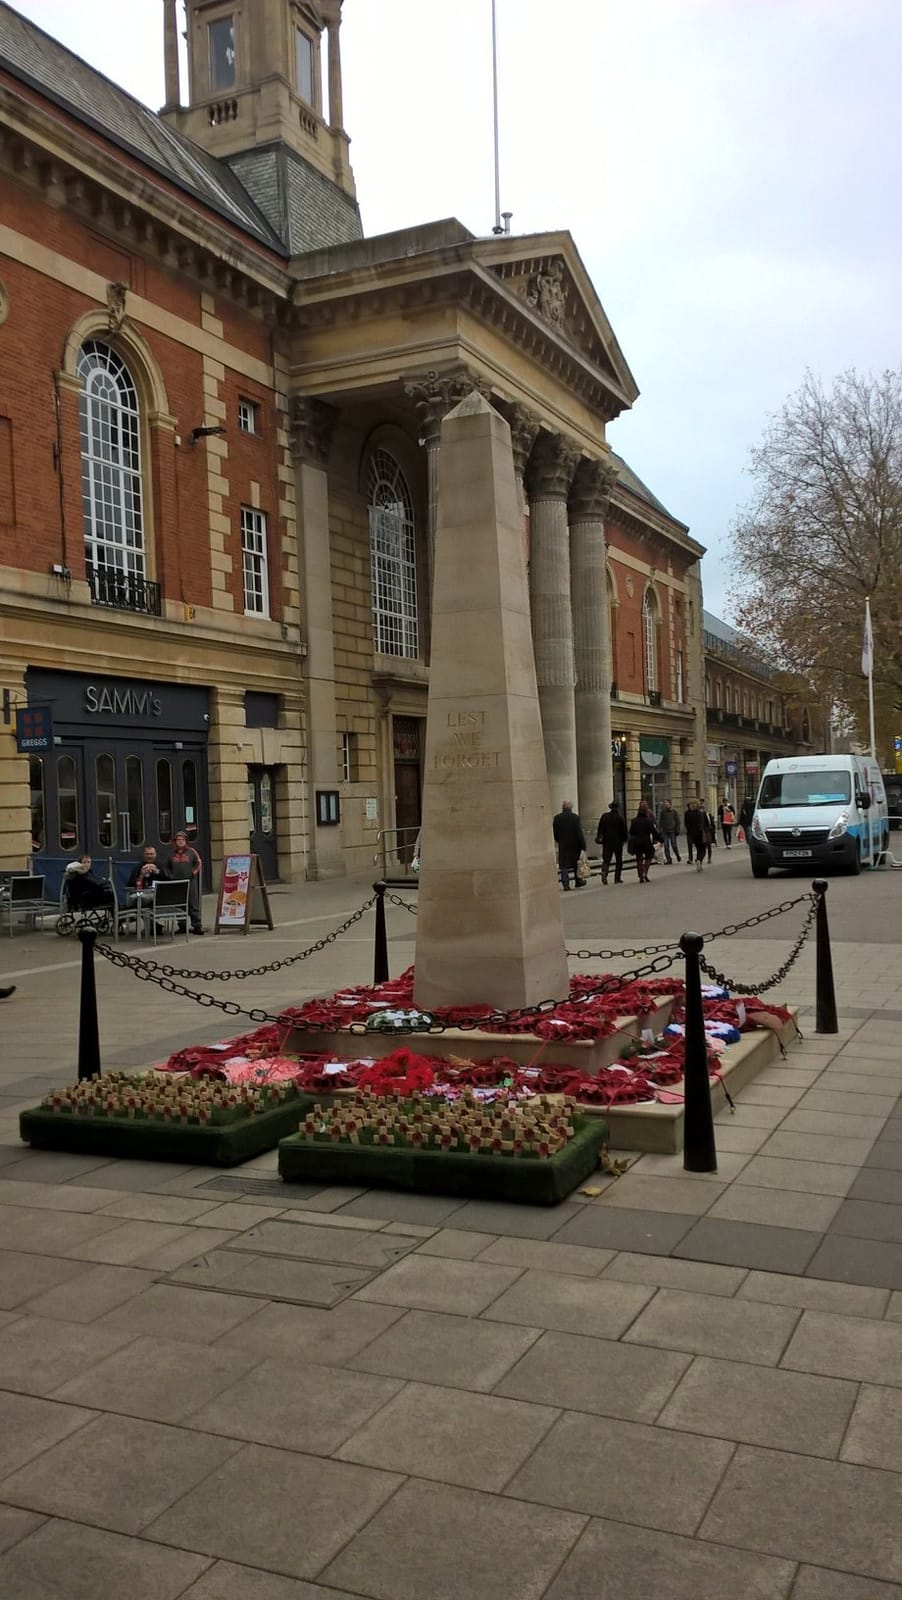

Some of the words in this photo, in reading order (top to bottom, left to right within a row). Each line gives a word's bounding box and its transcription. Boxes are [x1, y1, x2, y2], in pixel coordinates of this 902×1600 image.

[447, 710, 489, 728] LEST
[21, 737, 48, 748] GREGGS
[453, 730, 481, 746] WE
[434, 751, 502, 769] FORGET
